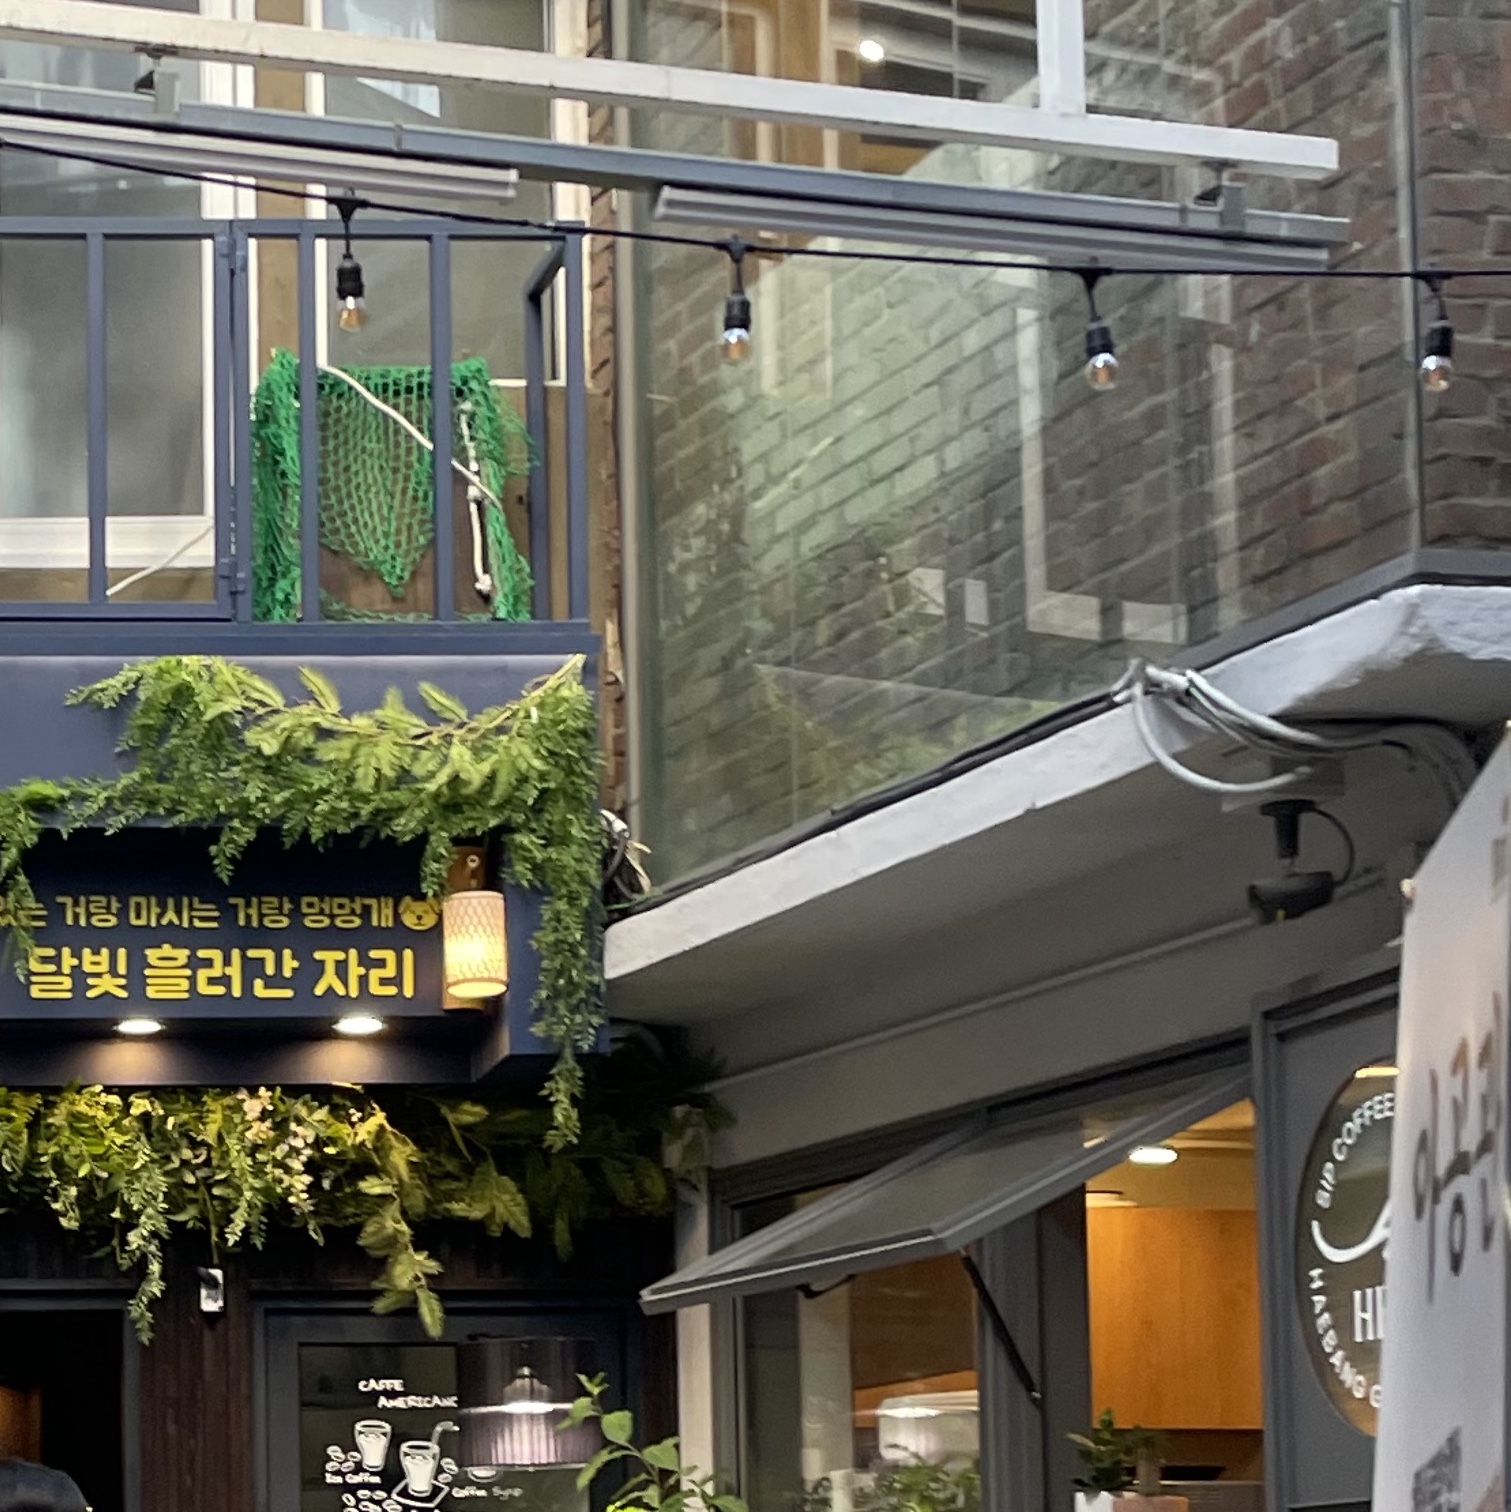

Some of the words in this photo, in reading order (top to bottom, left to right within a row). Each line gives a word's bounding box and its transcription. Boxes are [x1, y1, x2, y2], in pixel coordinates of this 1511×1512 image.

[56, 895, 121, 927] 거랑
[129, 895, 221, 929] 마시는
[228, 896, 294, 929] 거랑
[300, 896, 394, 929] 멍멍개
[28, 945, 129, 999] 달빛
[143, 944, 300, 999] 흘러간
[313, 947, 416, 999] 자리
